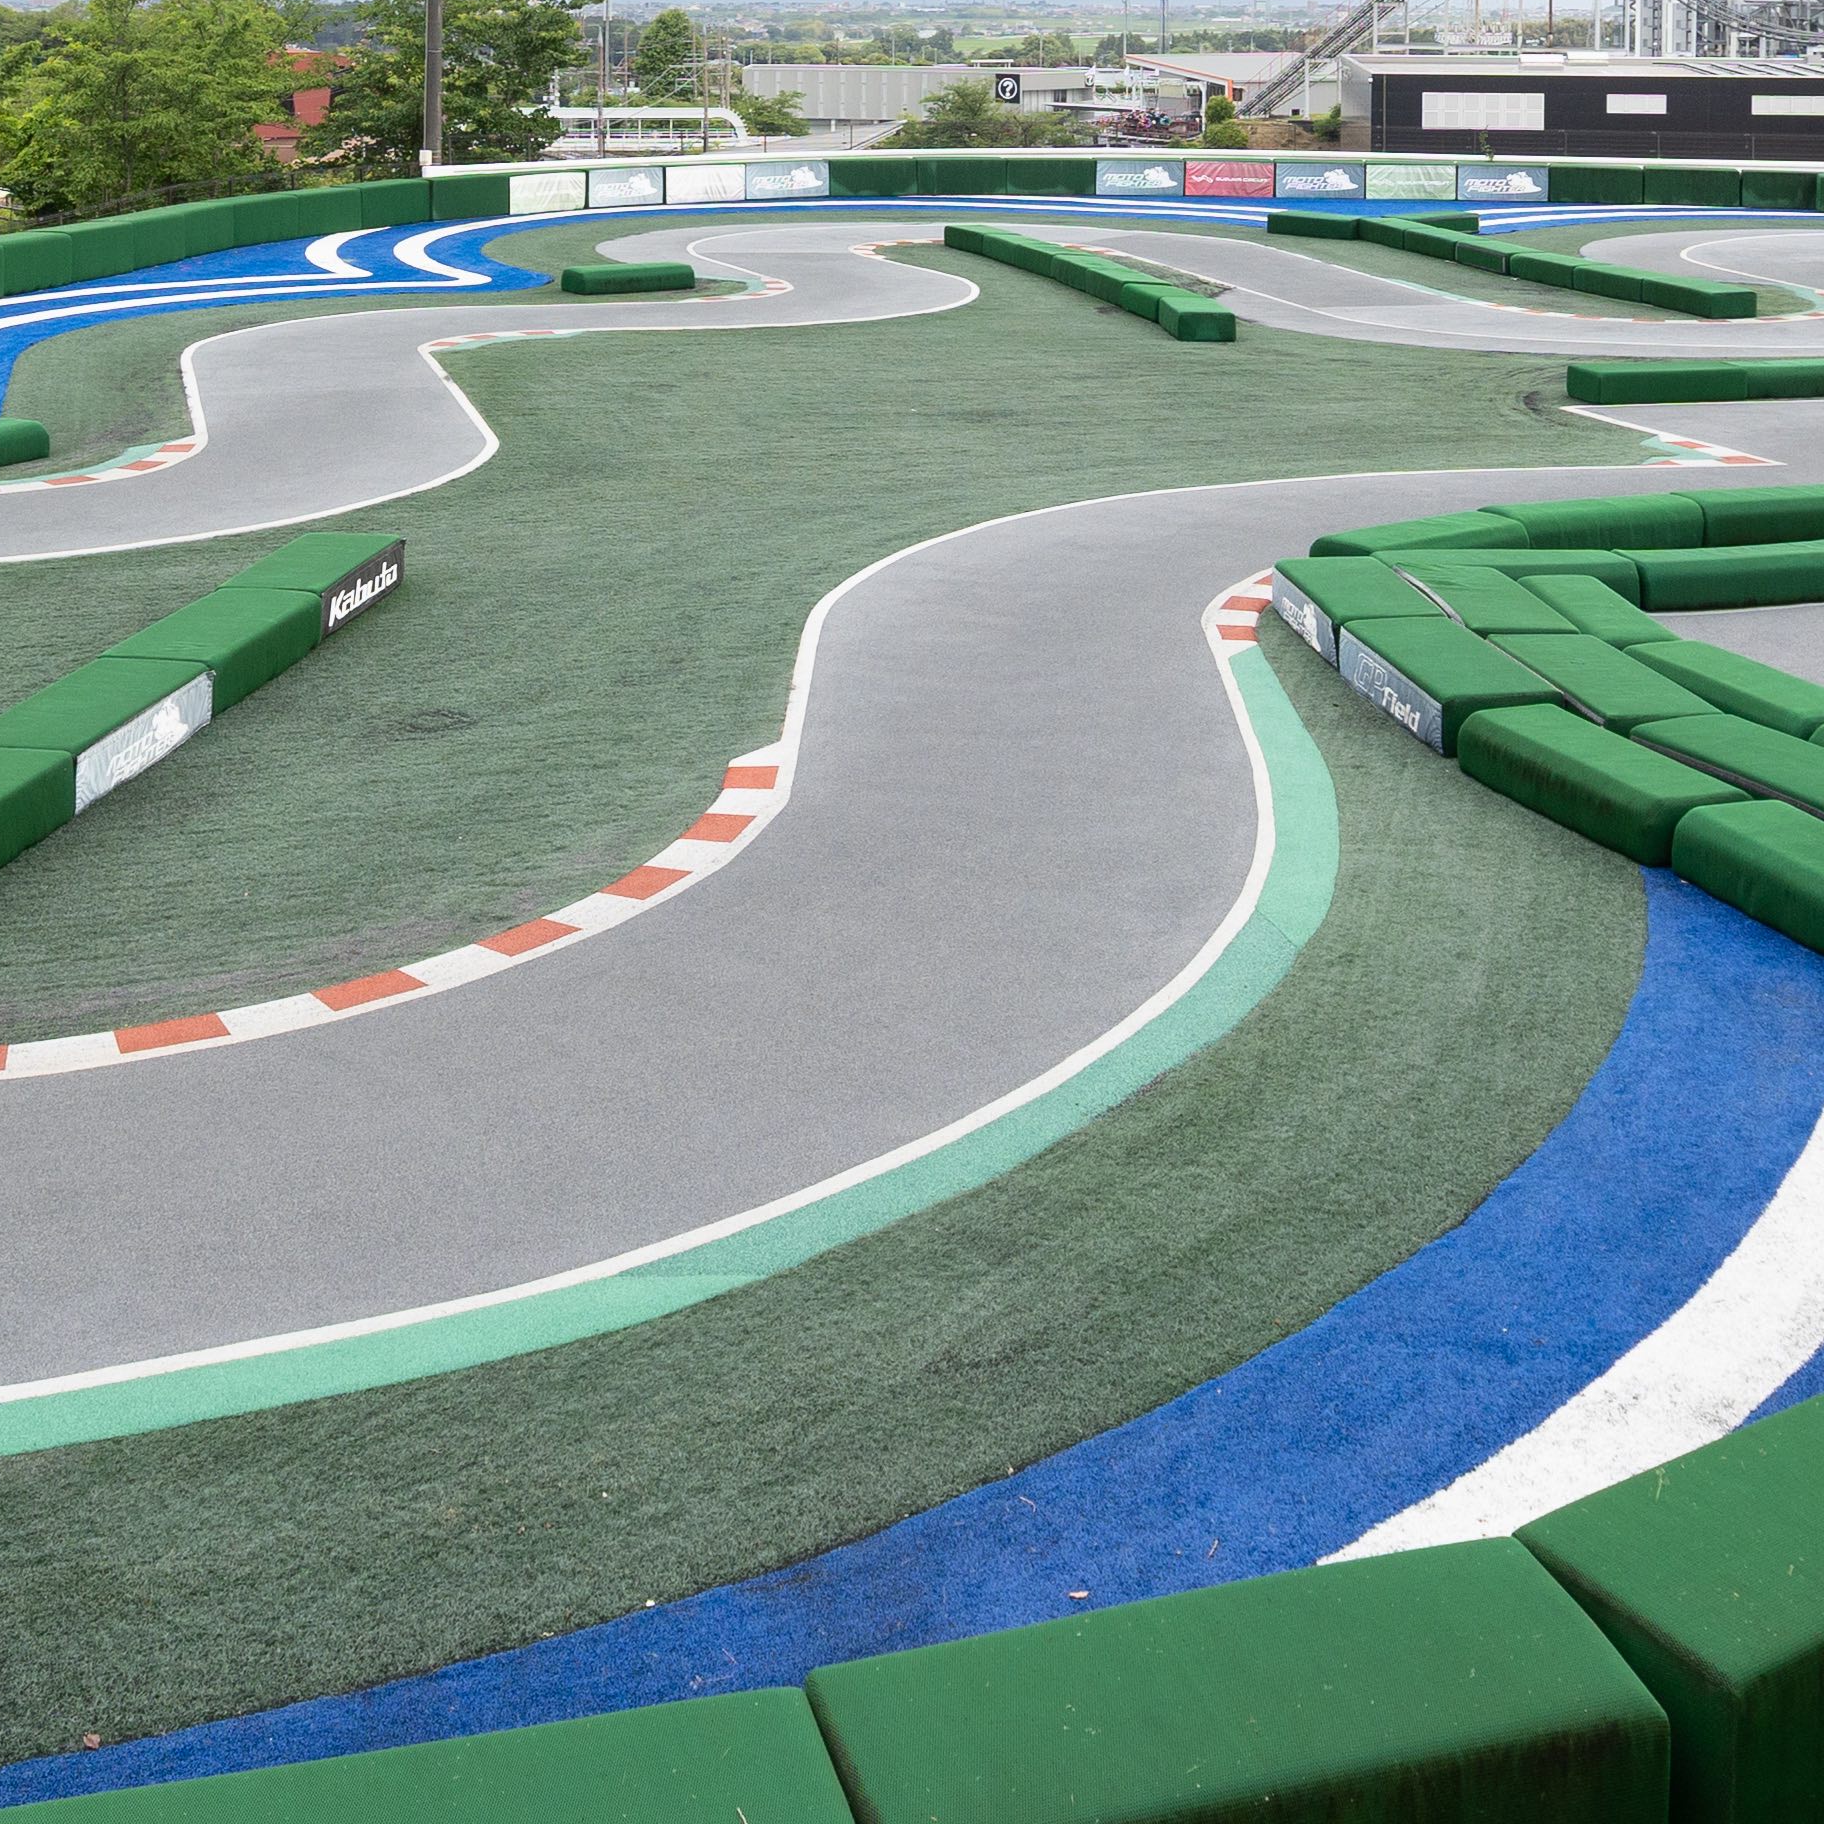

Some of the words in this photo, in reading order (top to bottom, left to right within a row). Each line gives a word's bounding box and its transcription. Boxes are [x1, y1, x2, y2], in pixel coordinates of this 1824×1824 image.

[1103, 173, 1144, 181] MOTO
[1282, 176, 1325, 184] MOTO
[1464, 178, 1507, 186] MOTO
[328, 561, 398, 627] Kabuto
[1382, 686, 1421, 733] field
